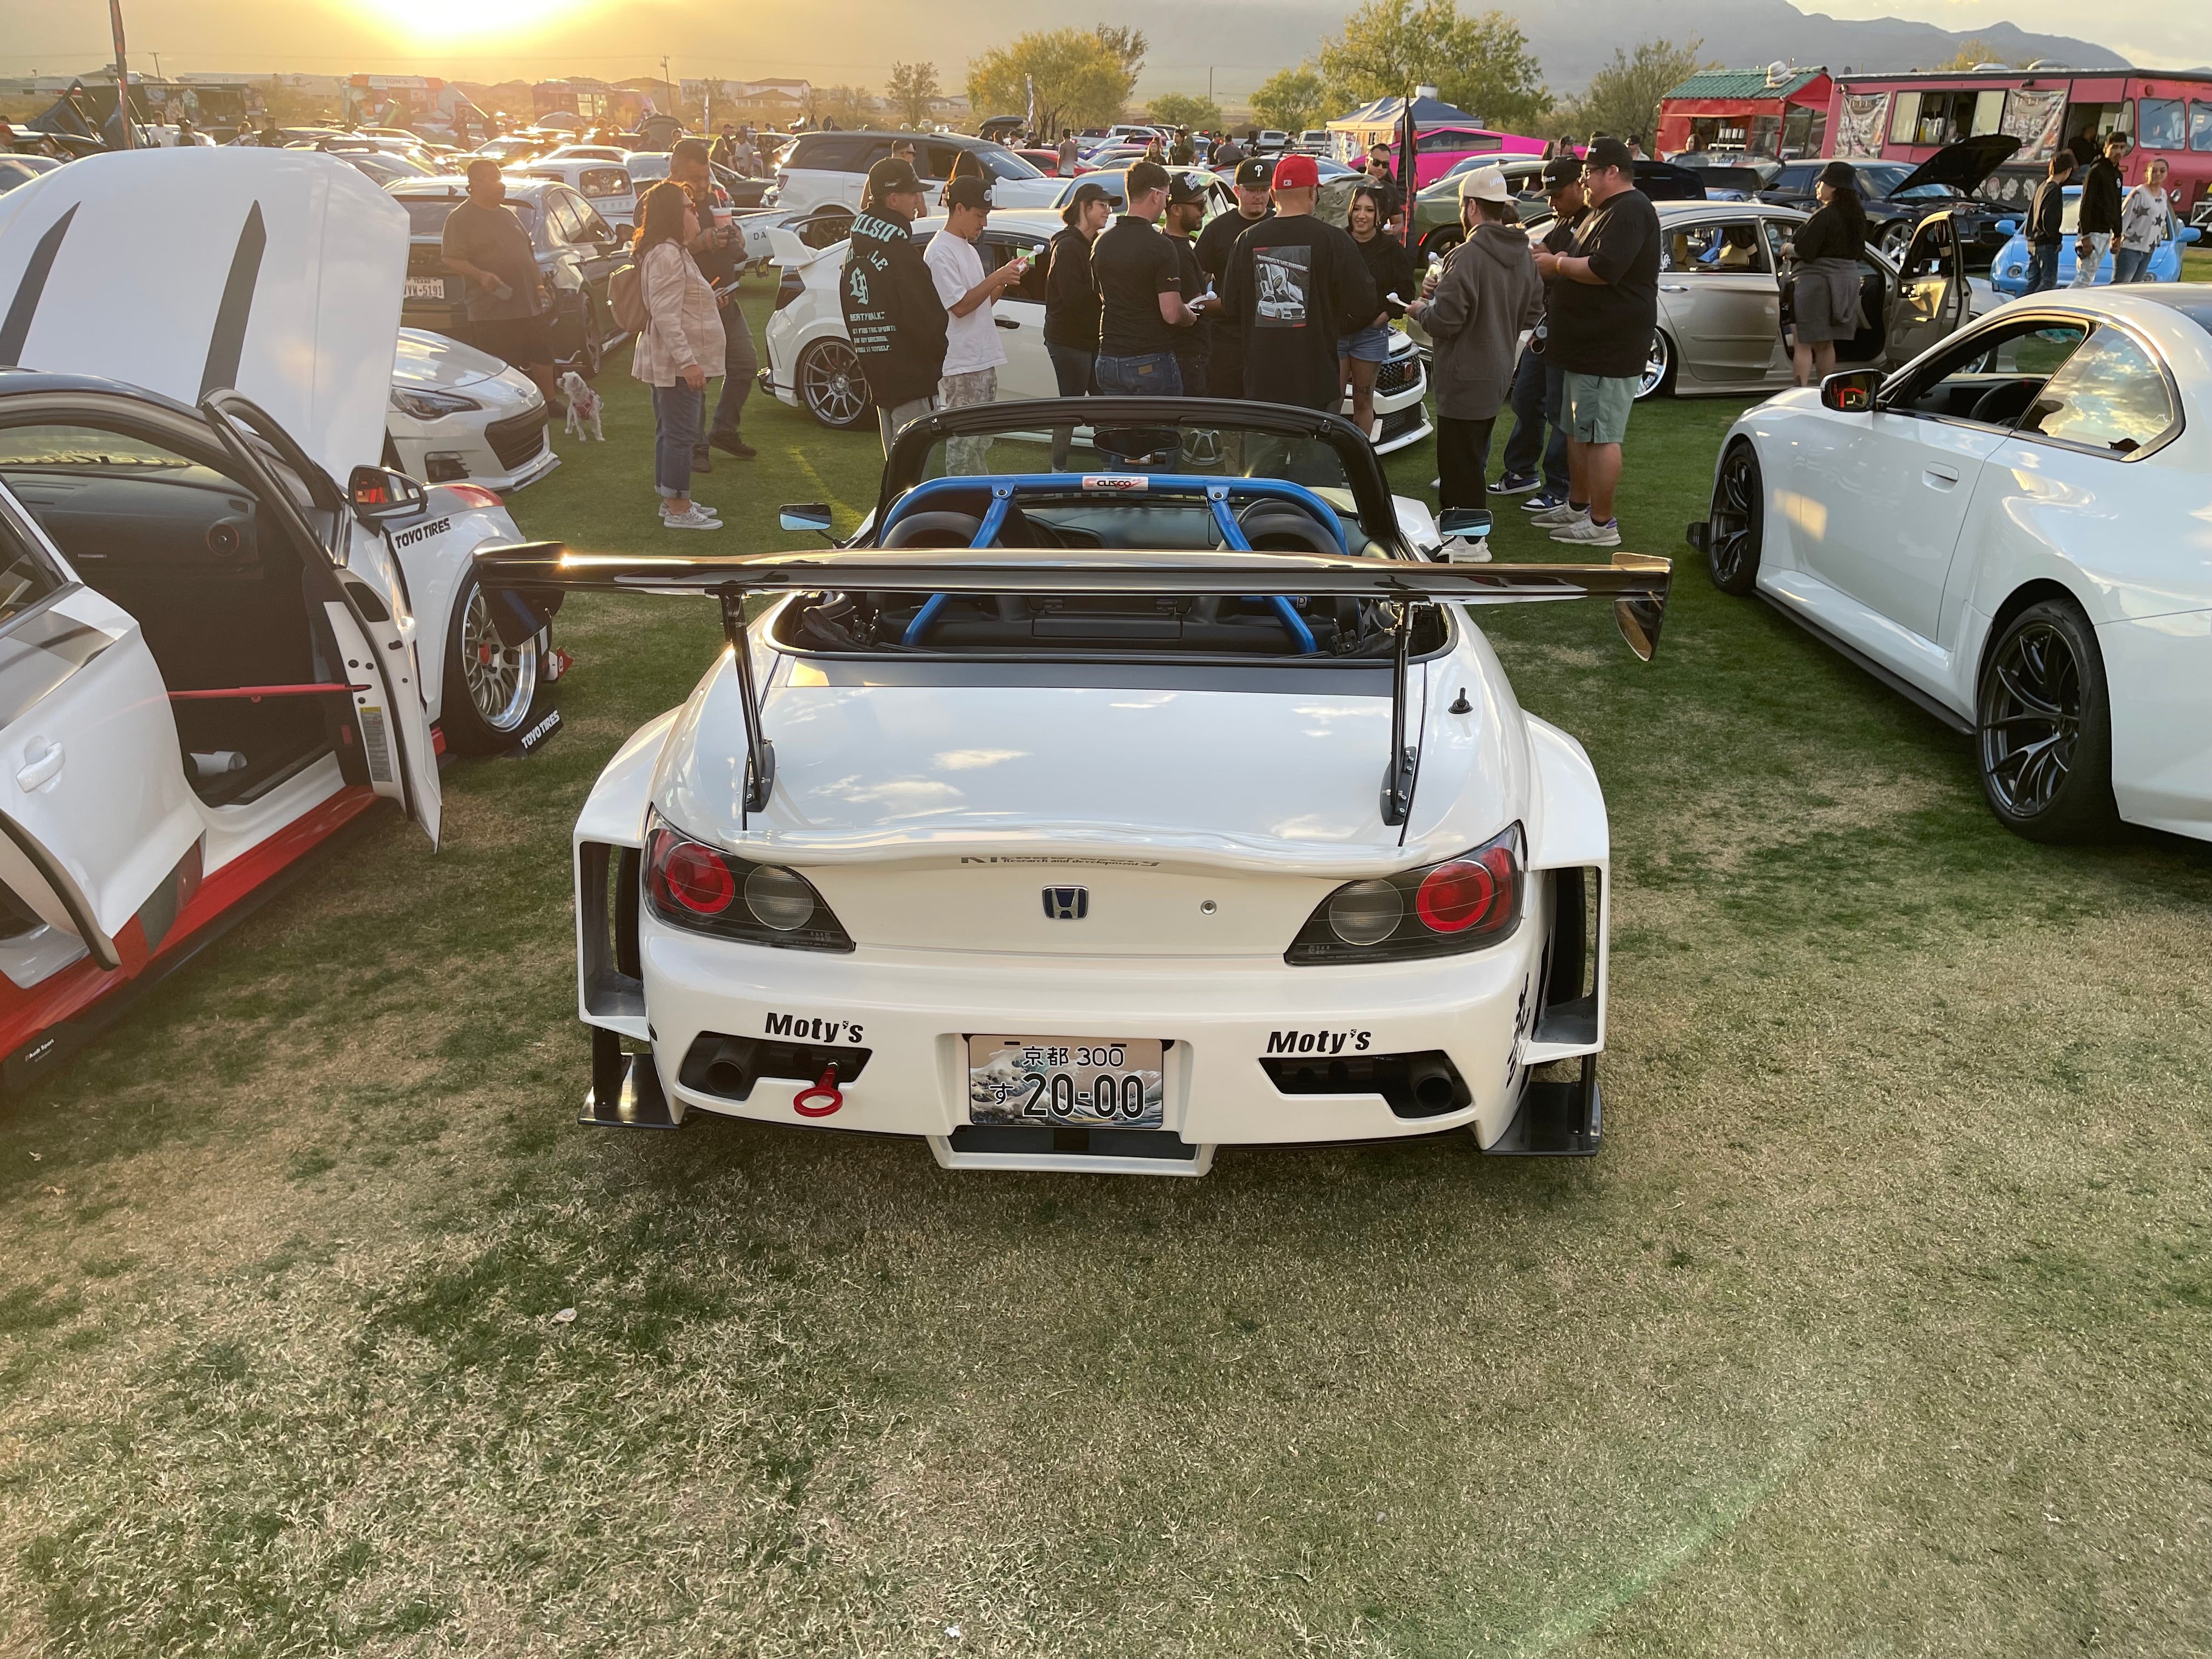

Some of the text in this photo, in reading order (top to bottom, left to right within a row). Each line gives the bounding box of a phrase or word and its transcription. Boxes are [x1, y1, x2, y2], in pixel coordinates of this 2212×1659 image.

[395, 517, 451, 549] TOYO TIRES
[521, 709, 560, 749] TOYO TIRES
[765, 1012, 864, 1043] Moty's
[1267, 1029, 1372, 1054] Moty's
[29, 1039, 54, 1059] Audi Sport
[1022, 1045, 1124, 1068] 京都 300
[989, 1072, 1145, 1119] す 20-00
